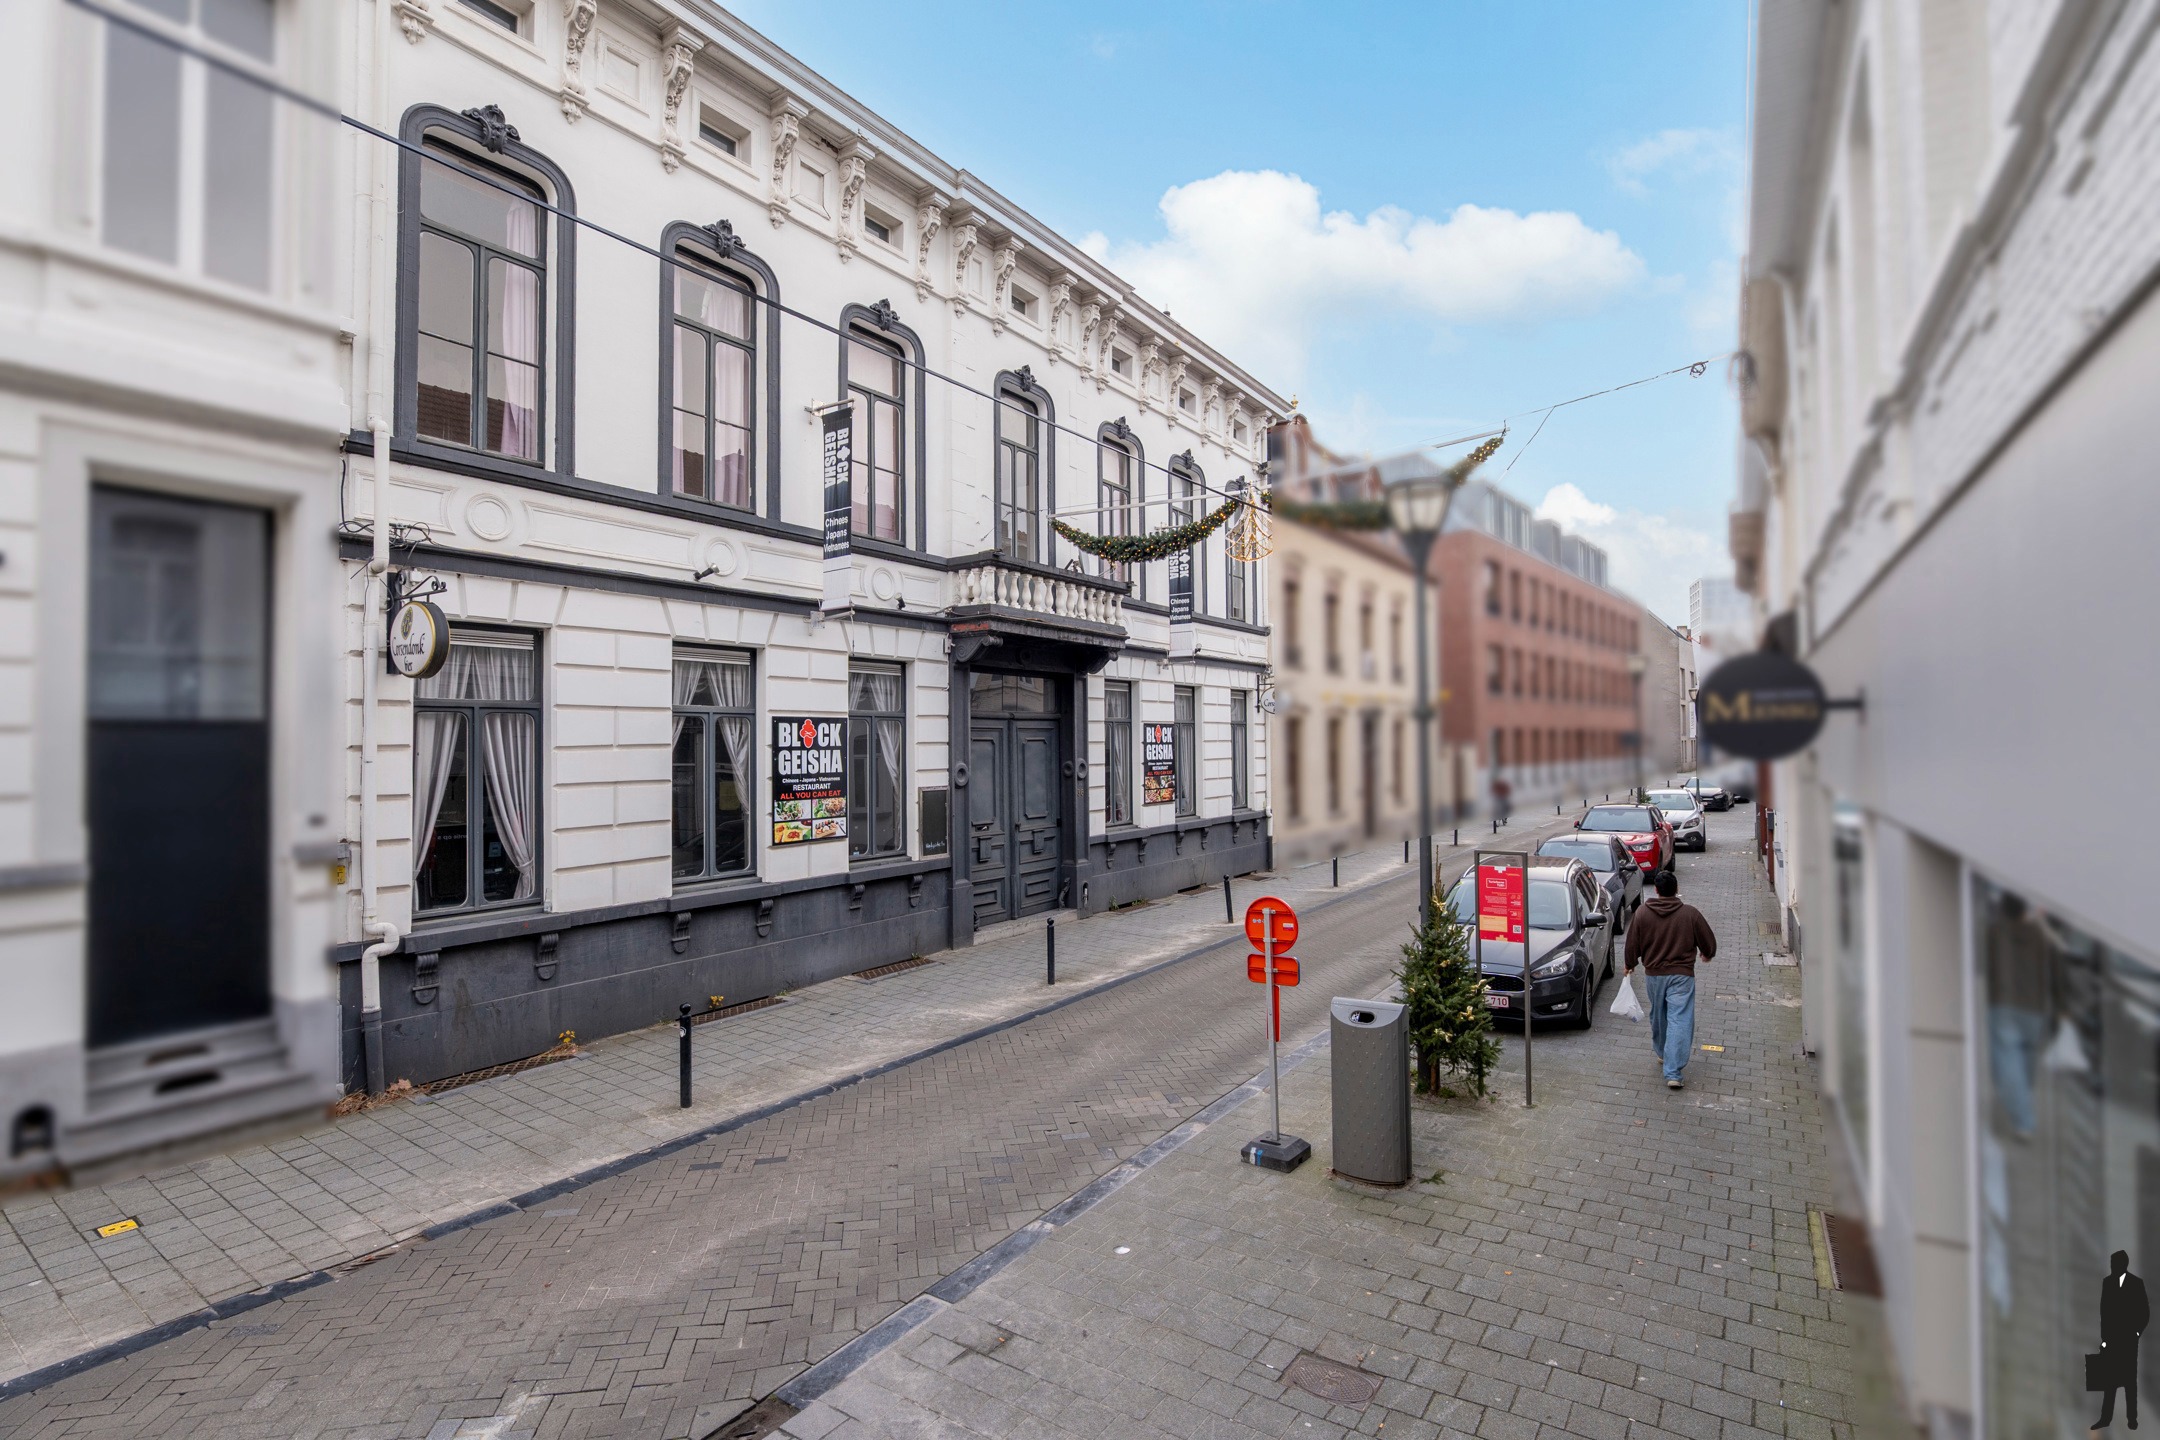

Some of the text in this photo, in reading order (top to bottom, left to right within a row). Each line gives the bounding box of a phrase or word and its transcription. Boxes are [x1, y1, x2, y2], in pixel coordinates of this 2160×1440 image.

[825, 431, 837, 489] GEISHA
[837, 427, 849, 485] BLCK
[825, 516, 848, 527] Chinees
[826, 529, 847, 540] Japans
[778, 722, 842, 747] BLCK
[1146, 726, 1172, 743] BLCK
[1146, 744, 1173, 760] GEISHA
[778, 749, 843, 775] GEISHA
[792, 783, 831, 791] RESTAURANT
[796, 791, 811, 799] YOU
